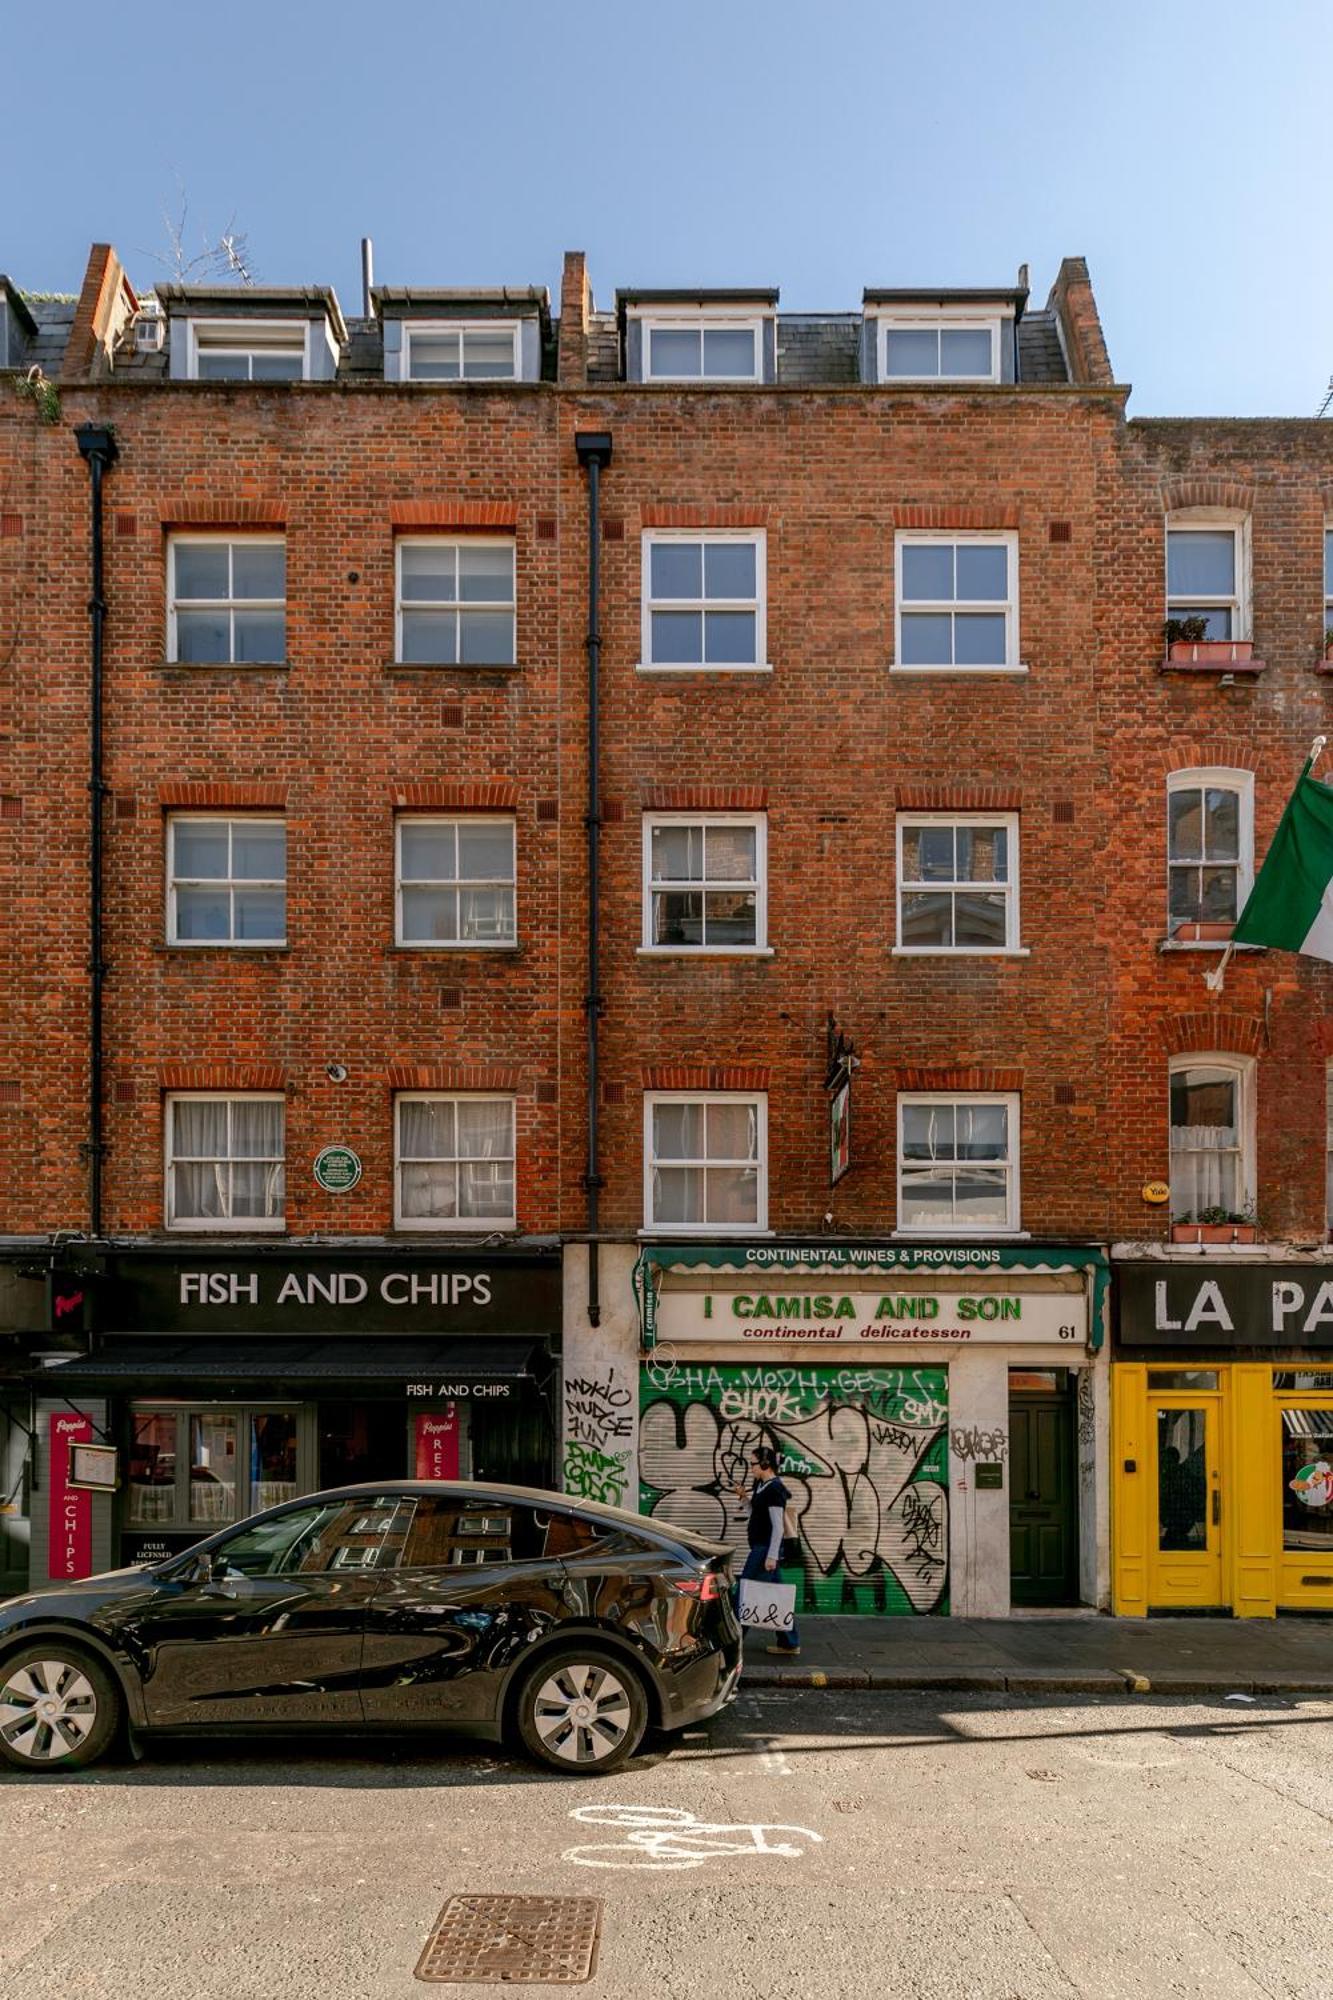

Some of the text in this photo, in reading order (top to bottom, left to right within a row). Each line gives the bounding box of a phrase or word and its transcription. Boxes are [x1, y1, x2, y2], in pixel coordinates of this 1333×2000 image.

[746, 1249, 1000, 1262] CONTINENTAL WINES & PROVISIONS
[180, 1273, 491, 1305] FISH AND CHIPS
[704, 1295, 1021, 1320] I CAMISA AND SON
[1155, 1280, 1333, 1332] LA PA
[743, 1325, 971, 1339] continental delicatessen
[1059, 1326, 1075, 1339] 61
[406, 1384, 510, 1397] FISH AND CHIPS
[65, 1505, 77, 1573] CHIPS
